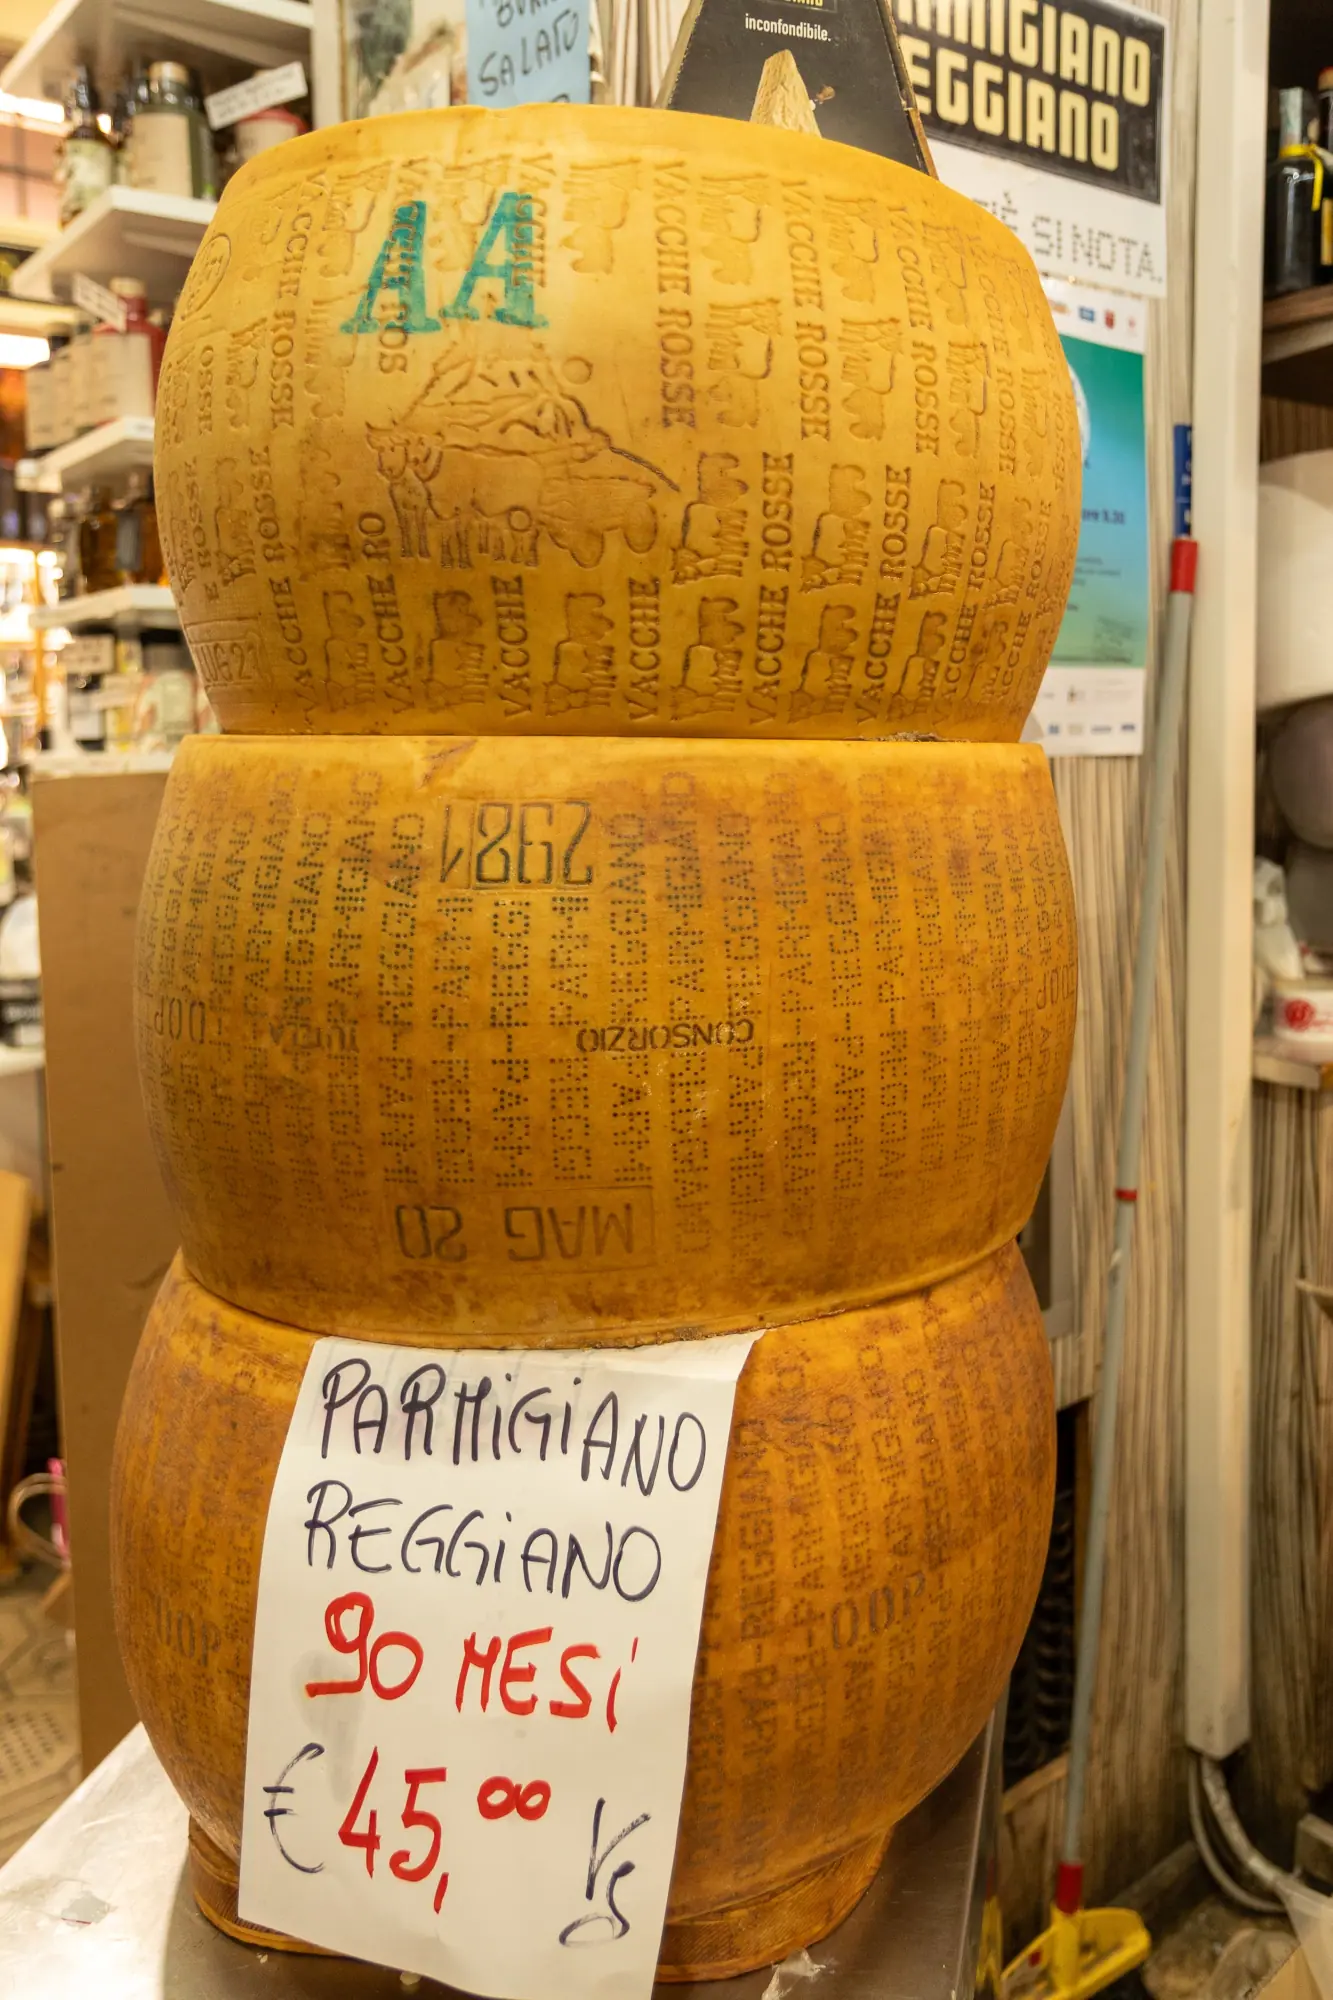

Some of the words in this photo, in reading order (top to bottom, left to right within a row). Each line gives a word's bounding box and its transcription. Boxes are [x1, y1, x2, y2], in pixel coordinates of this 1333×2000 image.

[478, 8, 580, 97] SALATO
[744, 12, 833, 43] inconfondibile.
[897, 0, 1152, 107] MIGIANO
[900, 34, 1121, 172] EGGIANO
[651, 160, 692, 297] VACCHE
[780, 180, 826, 312] VACCHE
[270, 307, 297, 430] ROSSE
[654, 305, 698, 430] ROSSE
[794, 319, 832, 443] ROSSE
[910, 340, 941, 458] ROSSE
[995, 366, 1018, 476] ROSSE
[248, 444, 285, 563] ROSSE
[760, 452, 795, 574] ROSSE
[967, 480, 996, 591] ROSSE
[367, 573, 416, 714] VACCHE
[490, 574, 532, 718] VACCHE
[623, 576, 662, 721] VACCHE
[747, 584, 790, 725] VACCHE
[854, 591, 901, 724] VACCHE
[879, 464, 912, 580] ROSSE
[326, 771, 382, 1026] PARMIGIANO
[377, 814, 424, 1027] REGGIANO
[606, 812, 648, 1024] REGGIANO
[815, 813, 862, 1008] REGGIANO
[903, 812, 944, 998] REGGIANO
[576, 1018, 755, 1053] CONSORZIO
[394, 1204, 468, 1263] 20
[504, 1202, 634, 1262] MAG
[304, 1591, 426, 1700] 90
[262, 1742, 326, 1874] €
